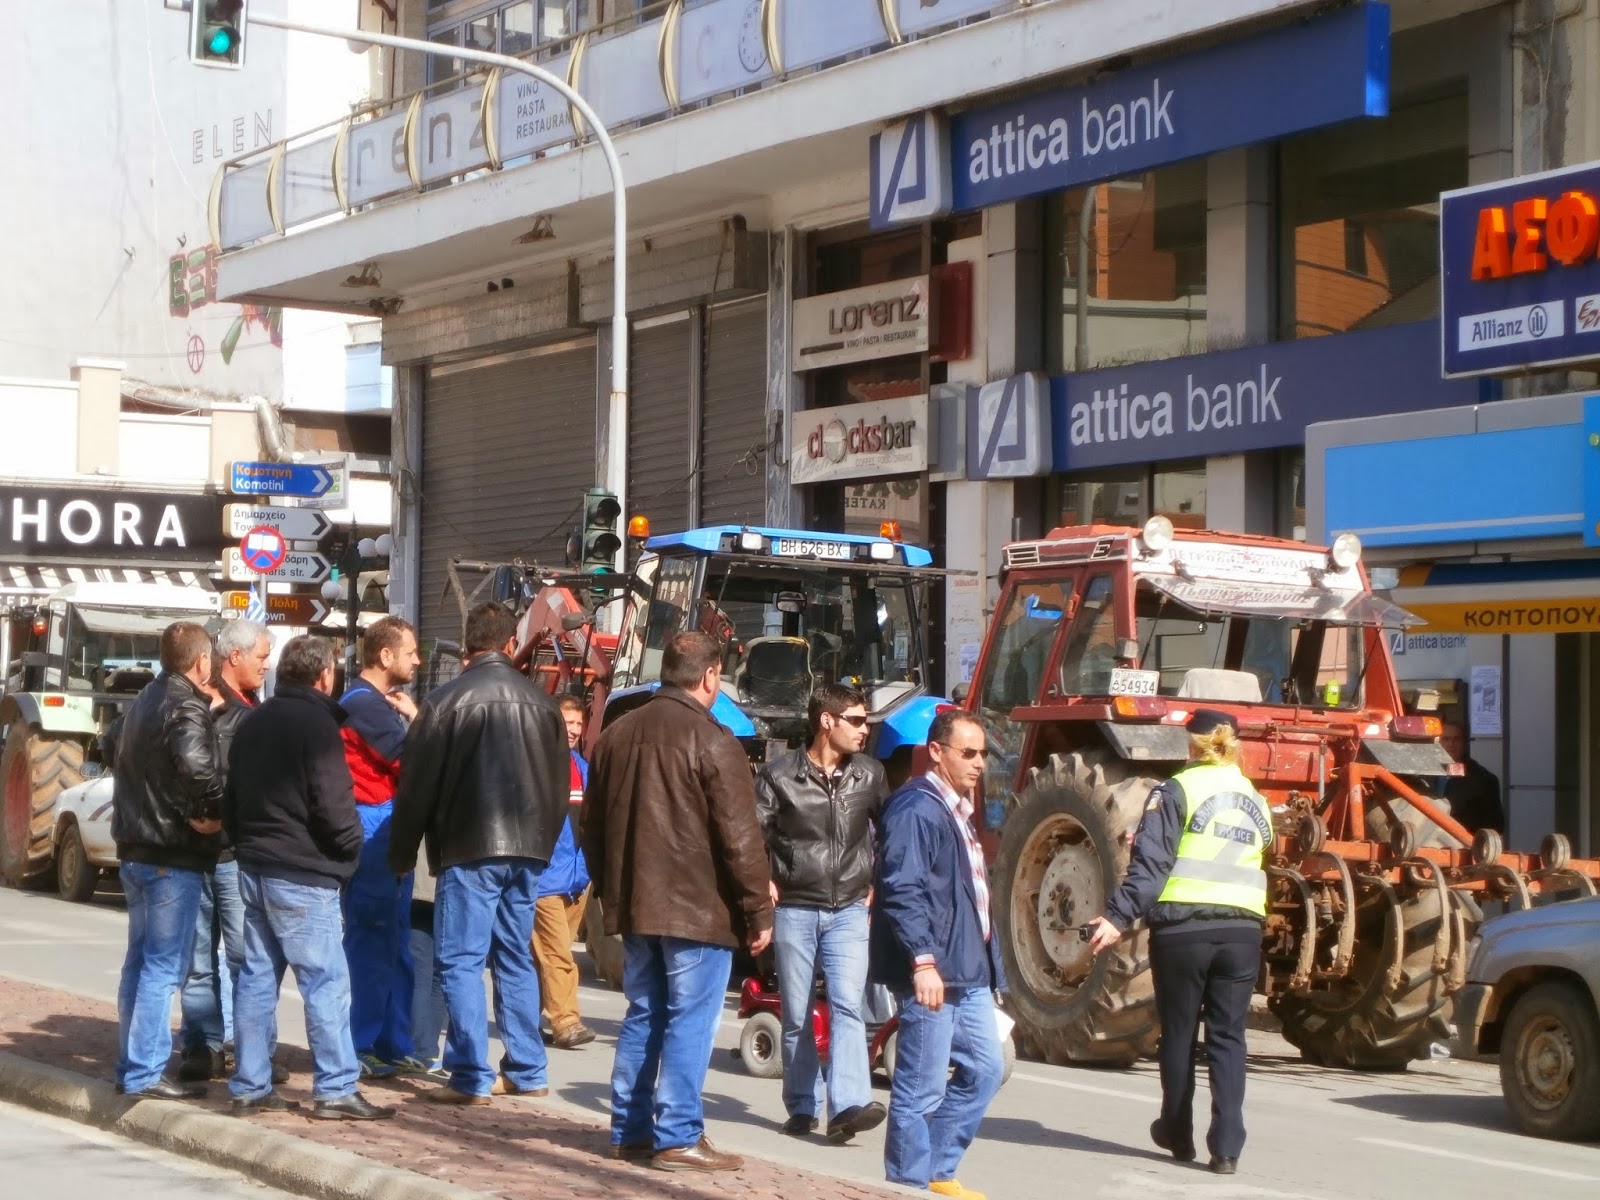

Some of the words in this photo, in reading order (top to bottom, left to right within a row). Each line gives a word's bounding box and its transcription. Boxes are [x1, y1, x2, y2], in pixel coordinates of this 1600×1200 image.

[516, 80, 539, 99] VINO
[516, 99, 546, 119] PASTA
[516, 111, 572, 140] RESTAURAN
[969, 114, 1069, 184] attica
[1082, 78, 1175, 156] bank
[1471, 191, 1600, 280] ΑΣΦ
[1472, 319, 1523, 342] Allianz
[863, 337, 880, 346] PASTA
[1070, 382, 1173, 446] attica
[1187, 363, 1283, 432] bank
[236, 464, 293, 479] Κομοτηνή
[235, 478, 284, 491] Komotini
[0, 497, 187, 548] HORA
[234, 509, 286, 521] Δημαρχείο
[269, 597, 299, 611] Πόλη
[1464, 605, 1600, 627] ΚΟΝΤΟΠΟΥ
[1408, 634, 1438, 650] attica
[1440, 633, 1468, 649] bank
[1120, 679, 1155, 695] 54934
[1218, 827, 1252, 842] POLICE
